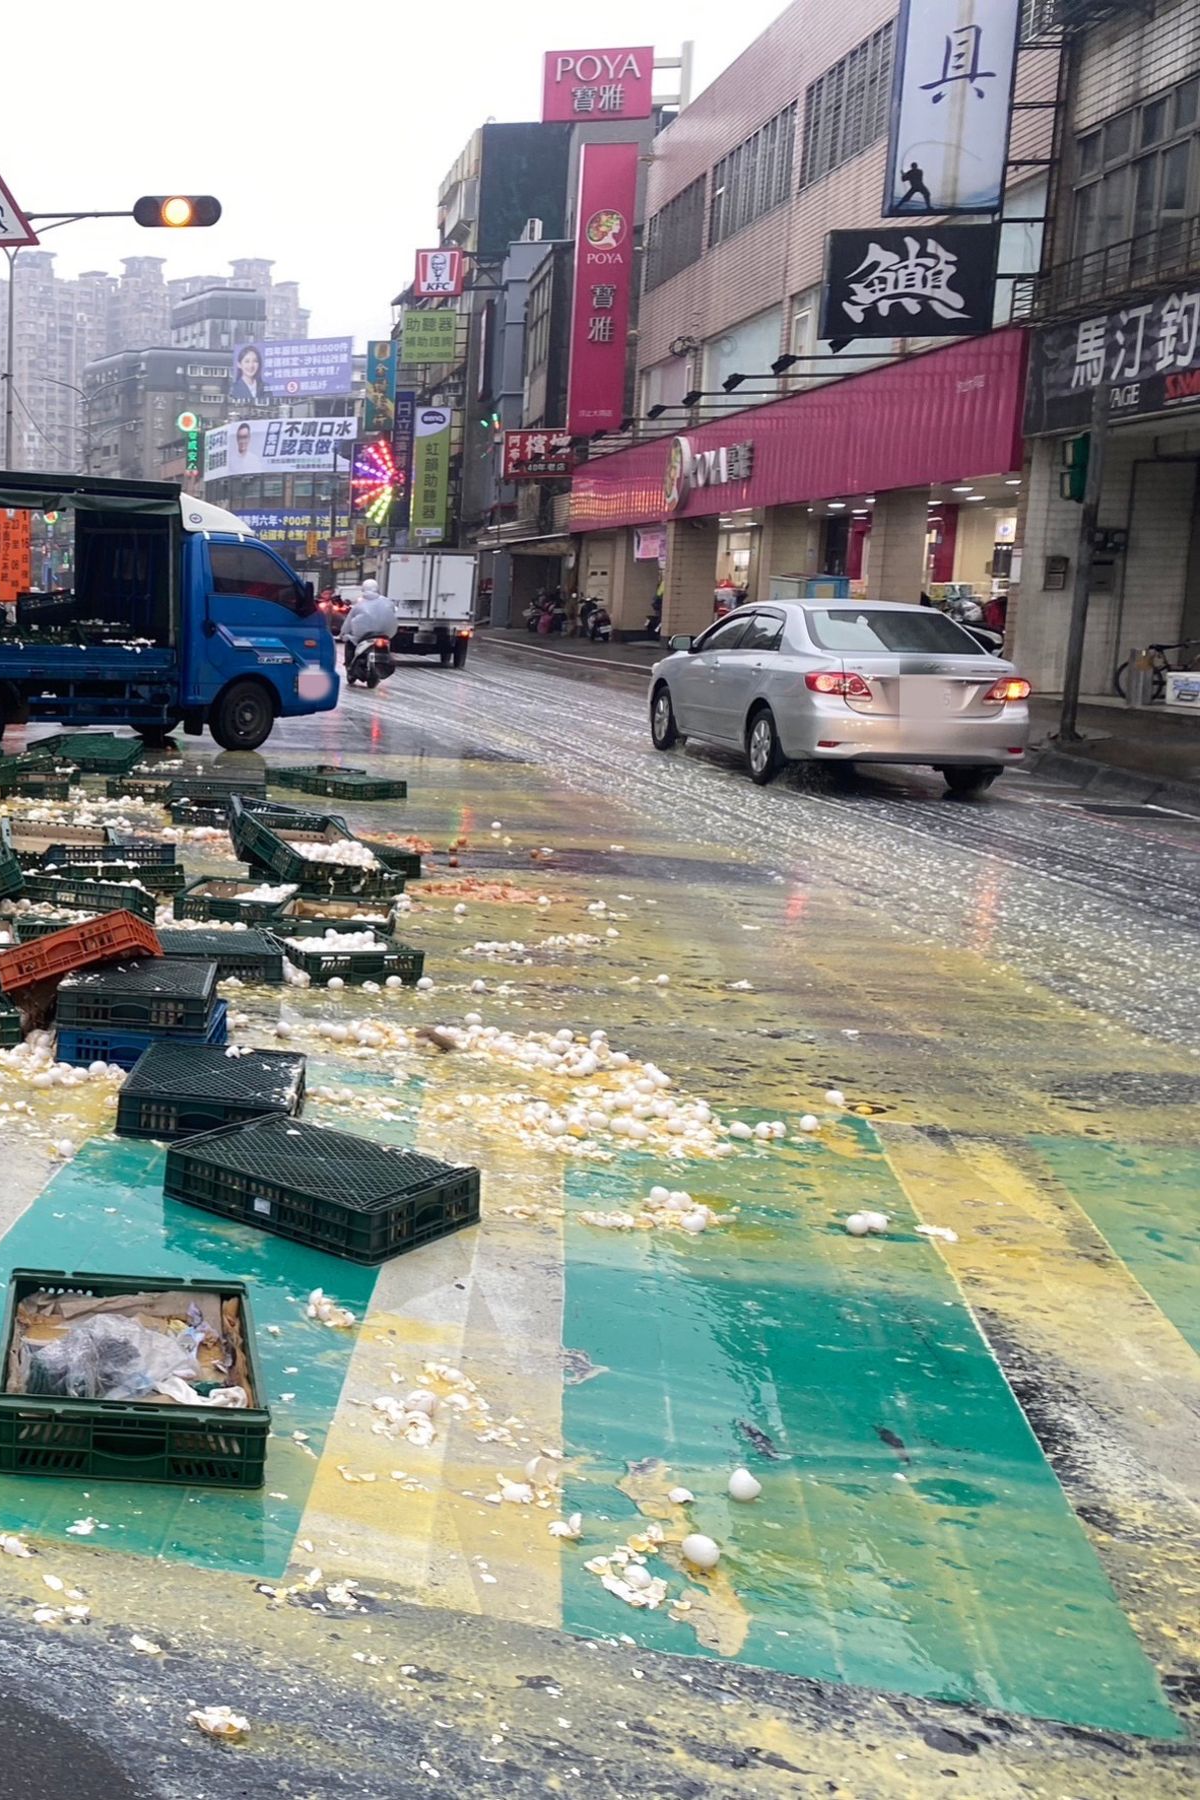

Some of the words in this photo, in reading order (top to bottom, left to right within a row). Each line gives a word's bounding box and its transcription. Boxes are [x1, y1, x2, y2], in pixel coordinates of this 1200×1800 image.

[556, 53, 641, 82] POYA
[918, 24, 997, 104] 具
[571, 83, 625, 112] 寶雅
[587, 252, 624, 265] POYA
[426, 282, 450, 290] KFC
[405, 317, 453, 332] 助聽器
[587, 284, 618, 342] 寶雅
